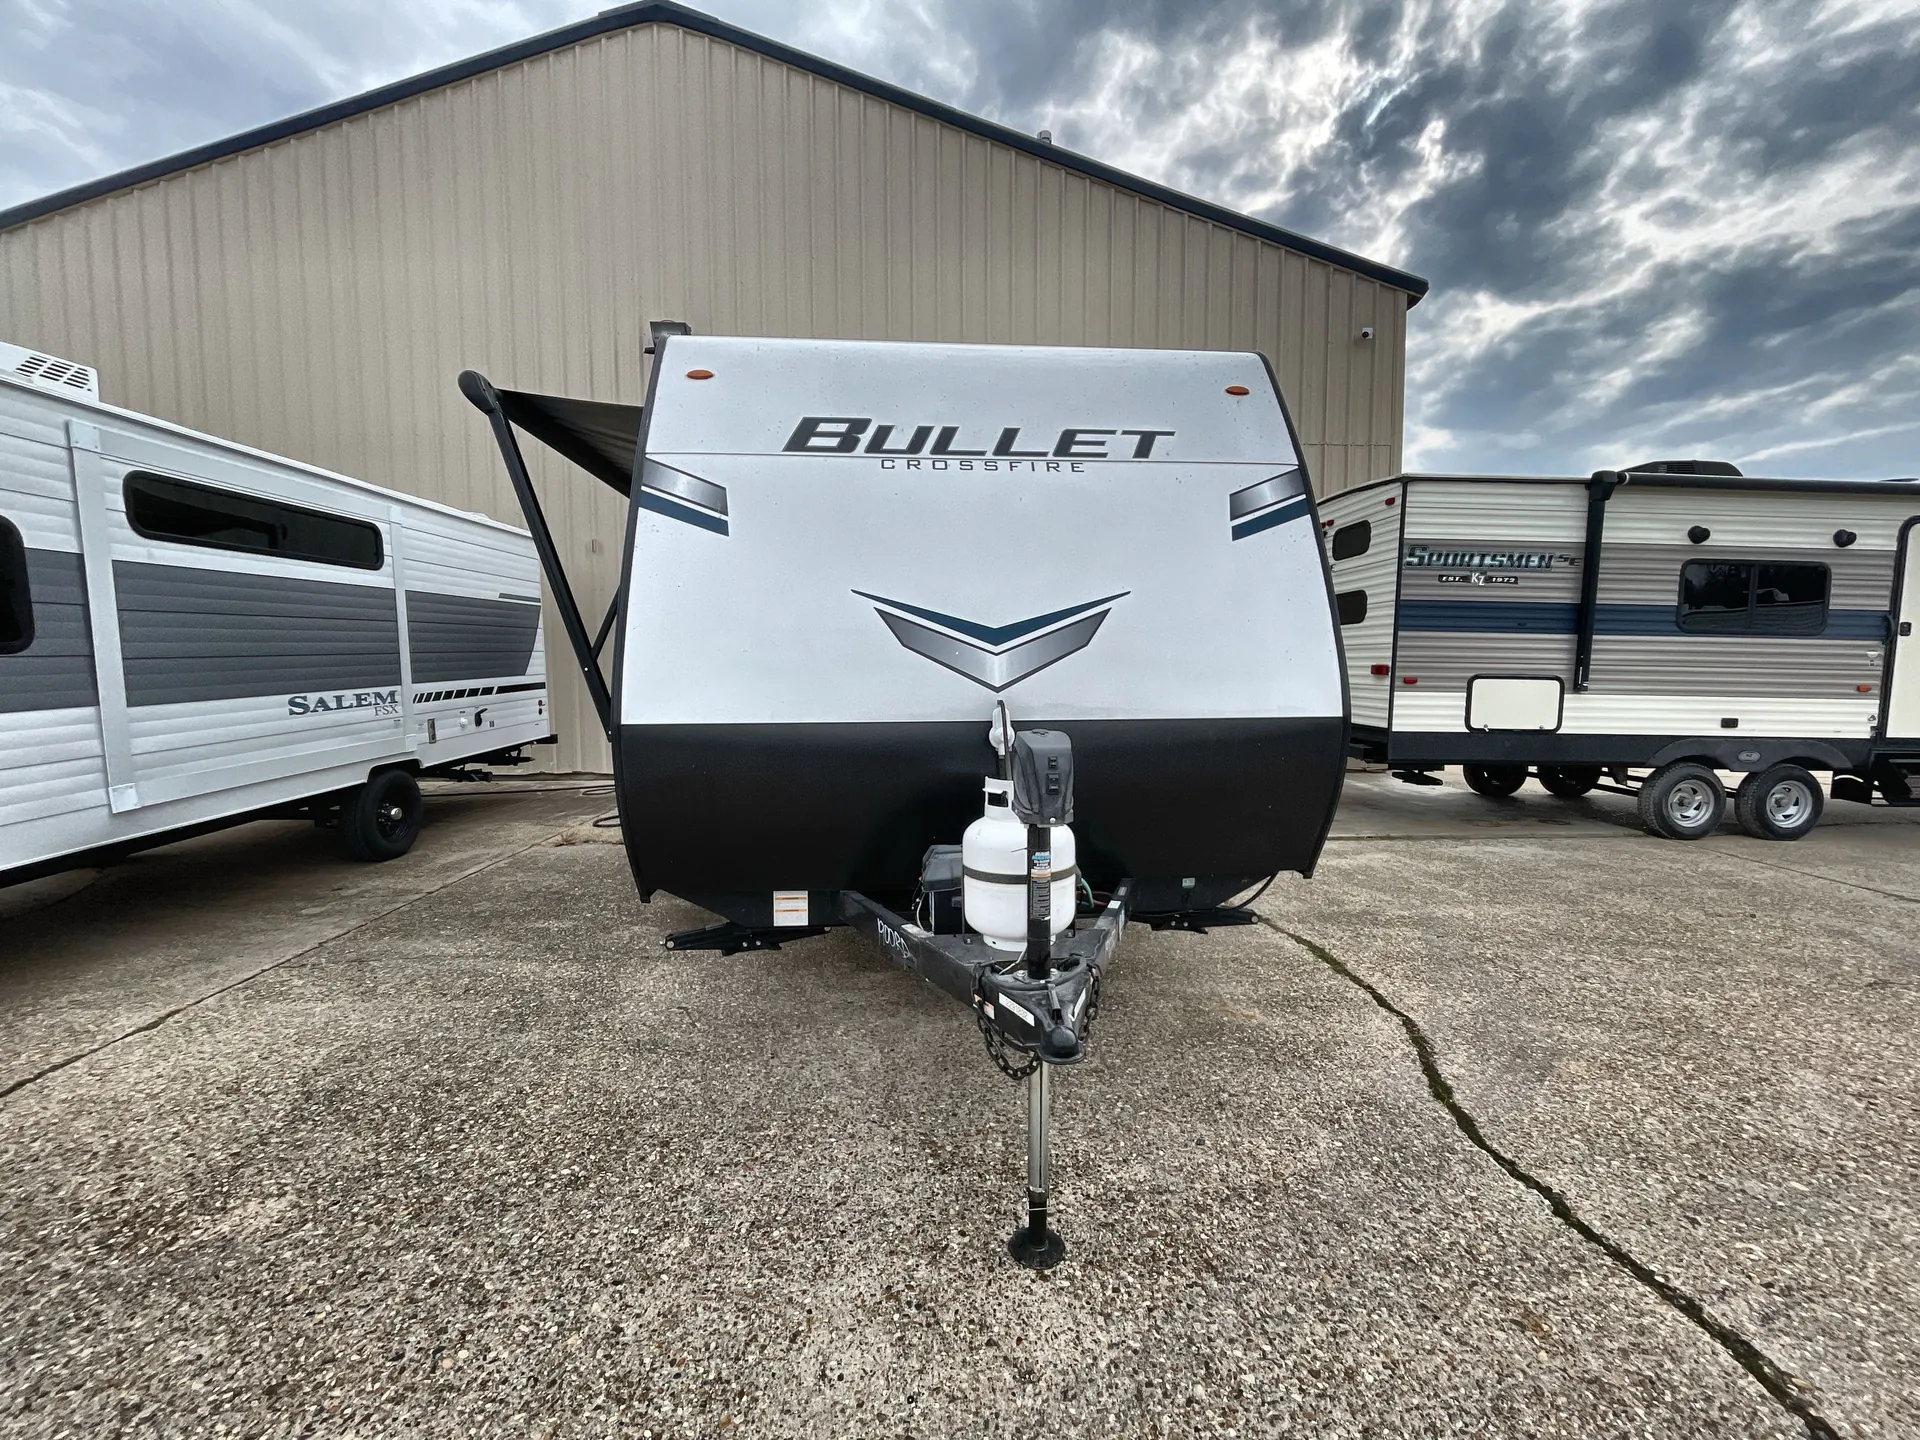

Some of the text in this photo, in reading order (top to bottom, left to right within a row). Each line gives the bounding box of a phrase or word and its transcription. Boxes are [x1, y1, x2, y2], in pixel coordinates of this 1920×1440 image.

[781, 416, 1176, 459] BULLET
[881, 459, 1085, 473] CROSSFIRE
[1403, 545, 1554, 569] SPORTSMEN
[287, 690, 399, 716] SALEM
[374, 704, 399, 717] FSX
